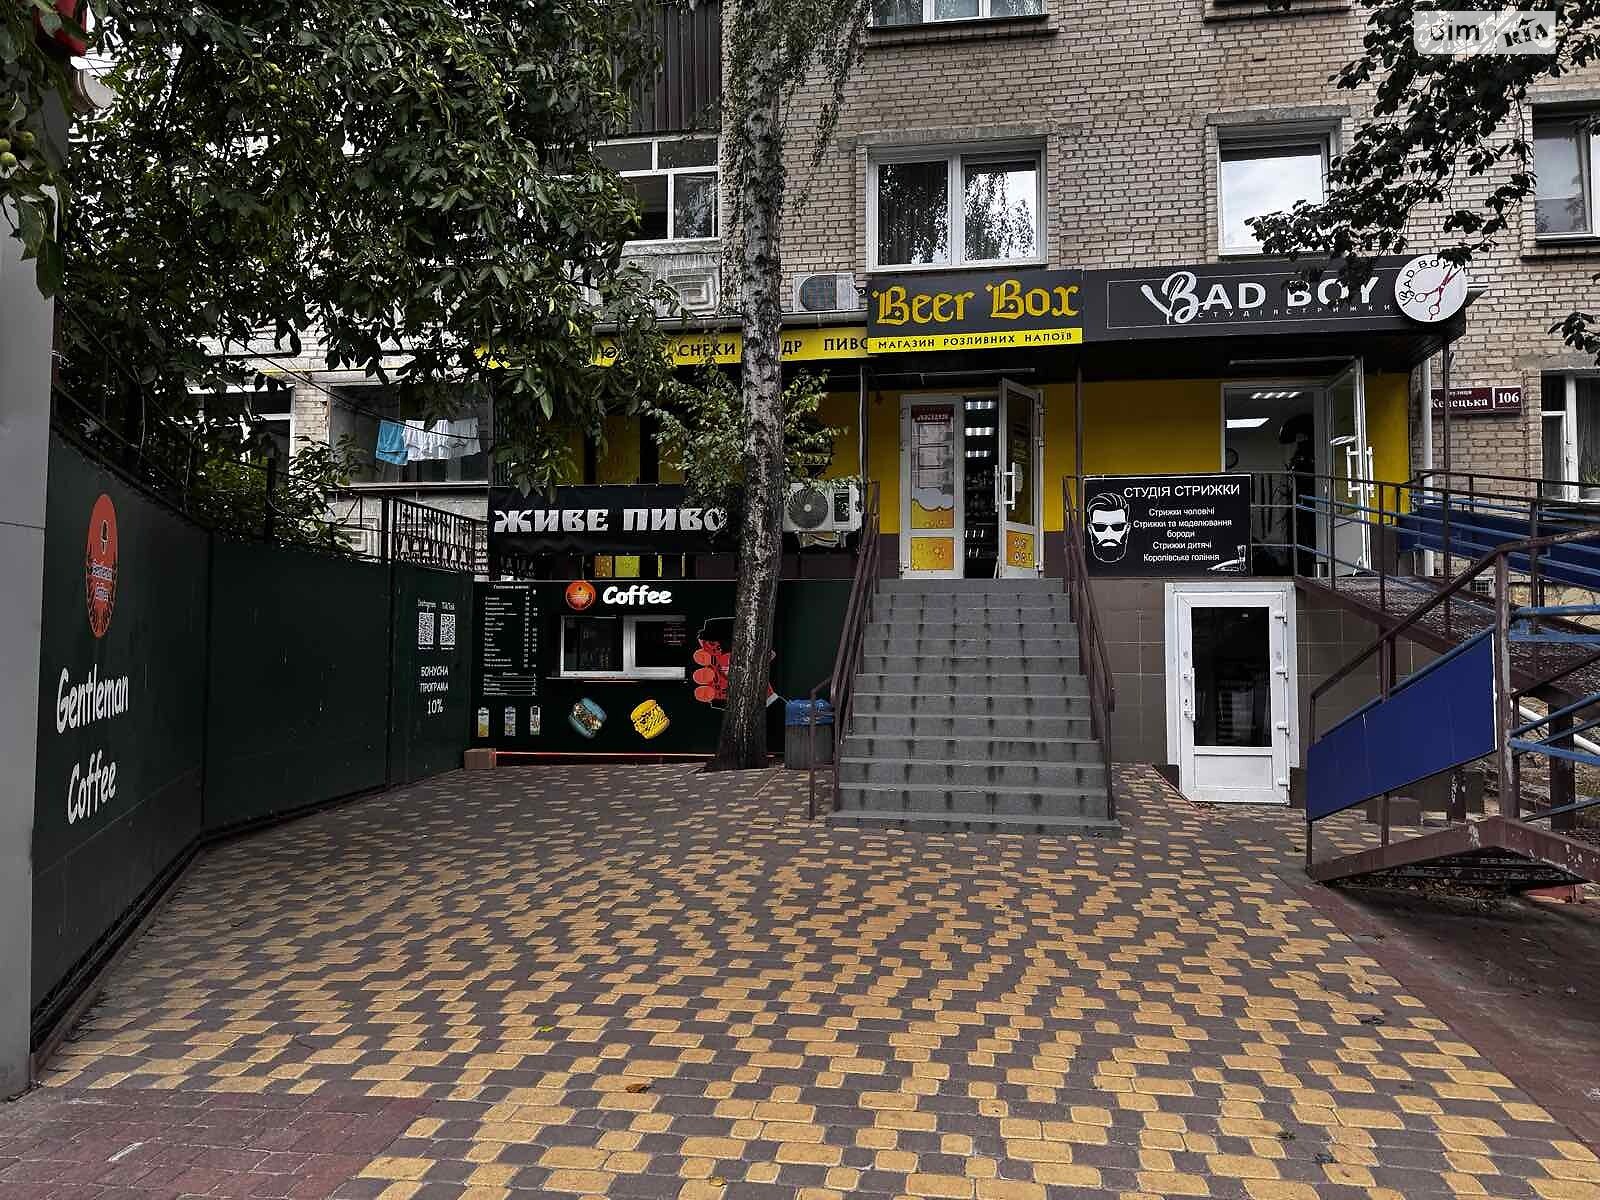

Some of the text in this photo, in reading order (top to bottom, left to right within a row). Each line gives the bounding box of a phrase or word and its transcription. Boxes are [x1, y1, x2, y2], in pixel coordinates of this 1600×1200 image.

[872, 279, 1079, 325] Beer Box
[1141, 271, 1266, 324] BAD
[878, 332, 1072, 349] МАГАЗИН РОЗЛИВНИХ НАПОЇВ
[1498, 392, 1519, 403] 106
[1124, 484, 1240, 499] СТУДІЯ СТРИЖКИ
[494, 508, 728, 532] ЖИВЕ ПИВО
[1148, 509, 1182, 517] Стрижки
[1166, 530, 1195, 539] бороди
[1187, 541, 1212, 550] дитячі
[1191, 553, 1220, 561] гоління
[603, 585, 673, 605] Coffee
[420, 681, 449, 693] ПРОГРАМА
[56, 663, 128, 734] Gentleman
[428, 698, 444, 714] 10%
[68, 749, 117, 824] Coffee
